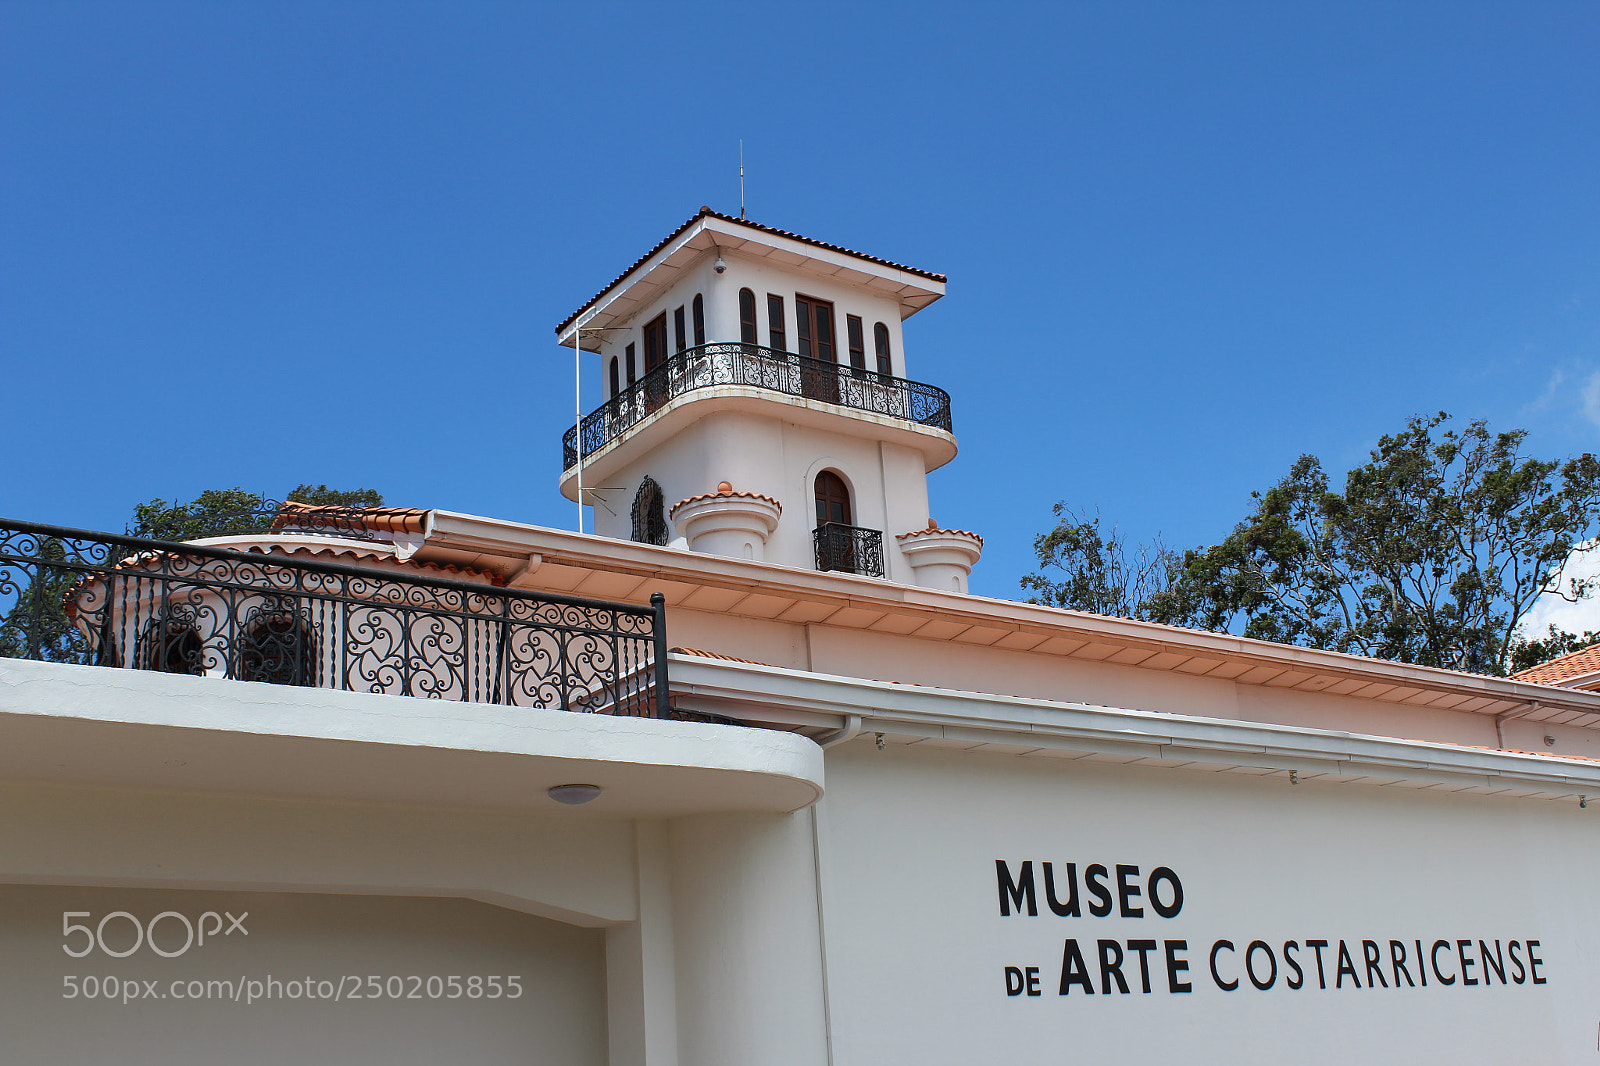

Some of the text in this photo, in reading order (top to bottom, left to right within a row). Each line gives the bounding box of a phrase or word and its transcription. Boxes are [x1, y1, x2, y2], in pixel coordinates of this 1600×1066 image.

[996, 860, 1184, 918] MUSEO
[1005, 938, 1547, 997] DE ARTE COSTARRICENSE
